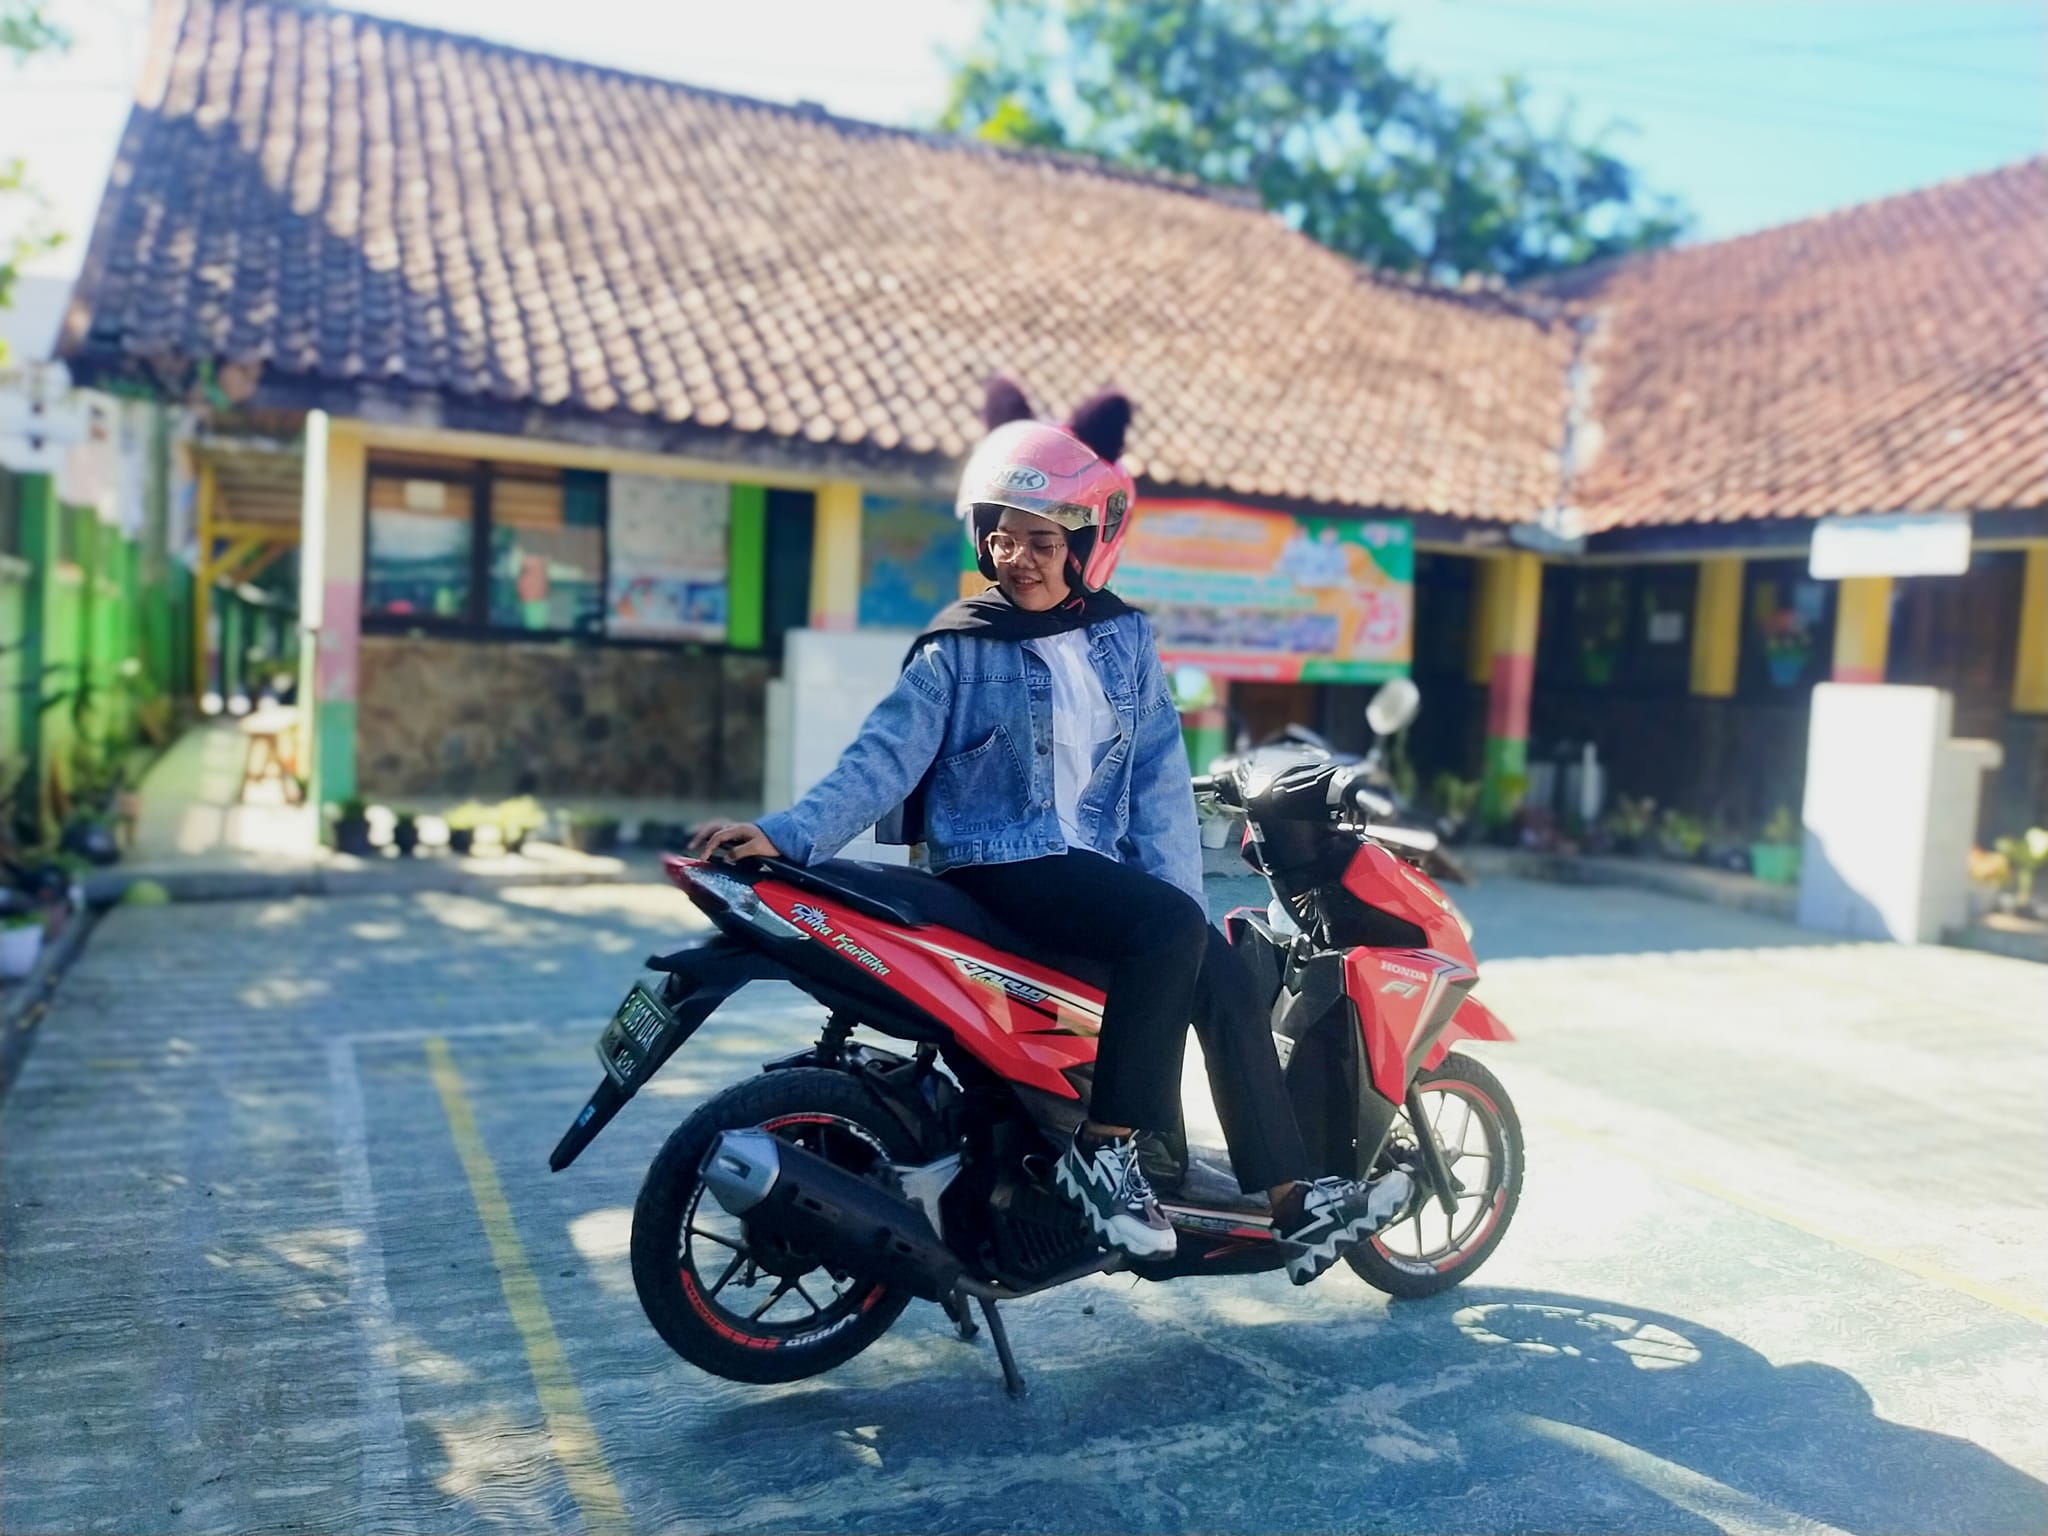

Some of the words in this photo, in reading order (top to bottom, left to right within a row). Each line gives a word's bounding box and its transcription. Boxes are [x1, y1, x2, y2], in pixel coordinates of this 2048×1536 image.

[996, 470, 1039, 488] NHK
[953, 959, 1049, 1001] VARIO
[1380, 959, 1429, 982] HONDA
[1380, 979, 1421, 999] FI
